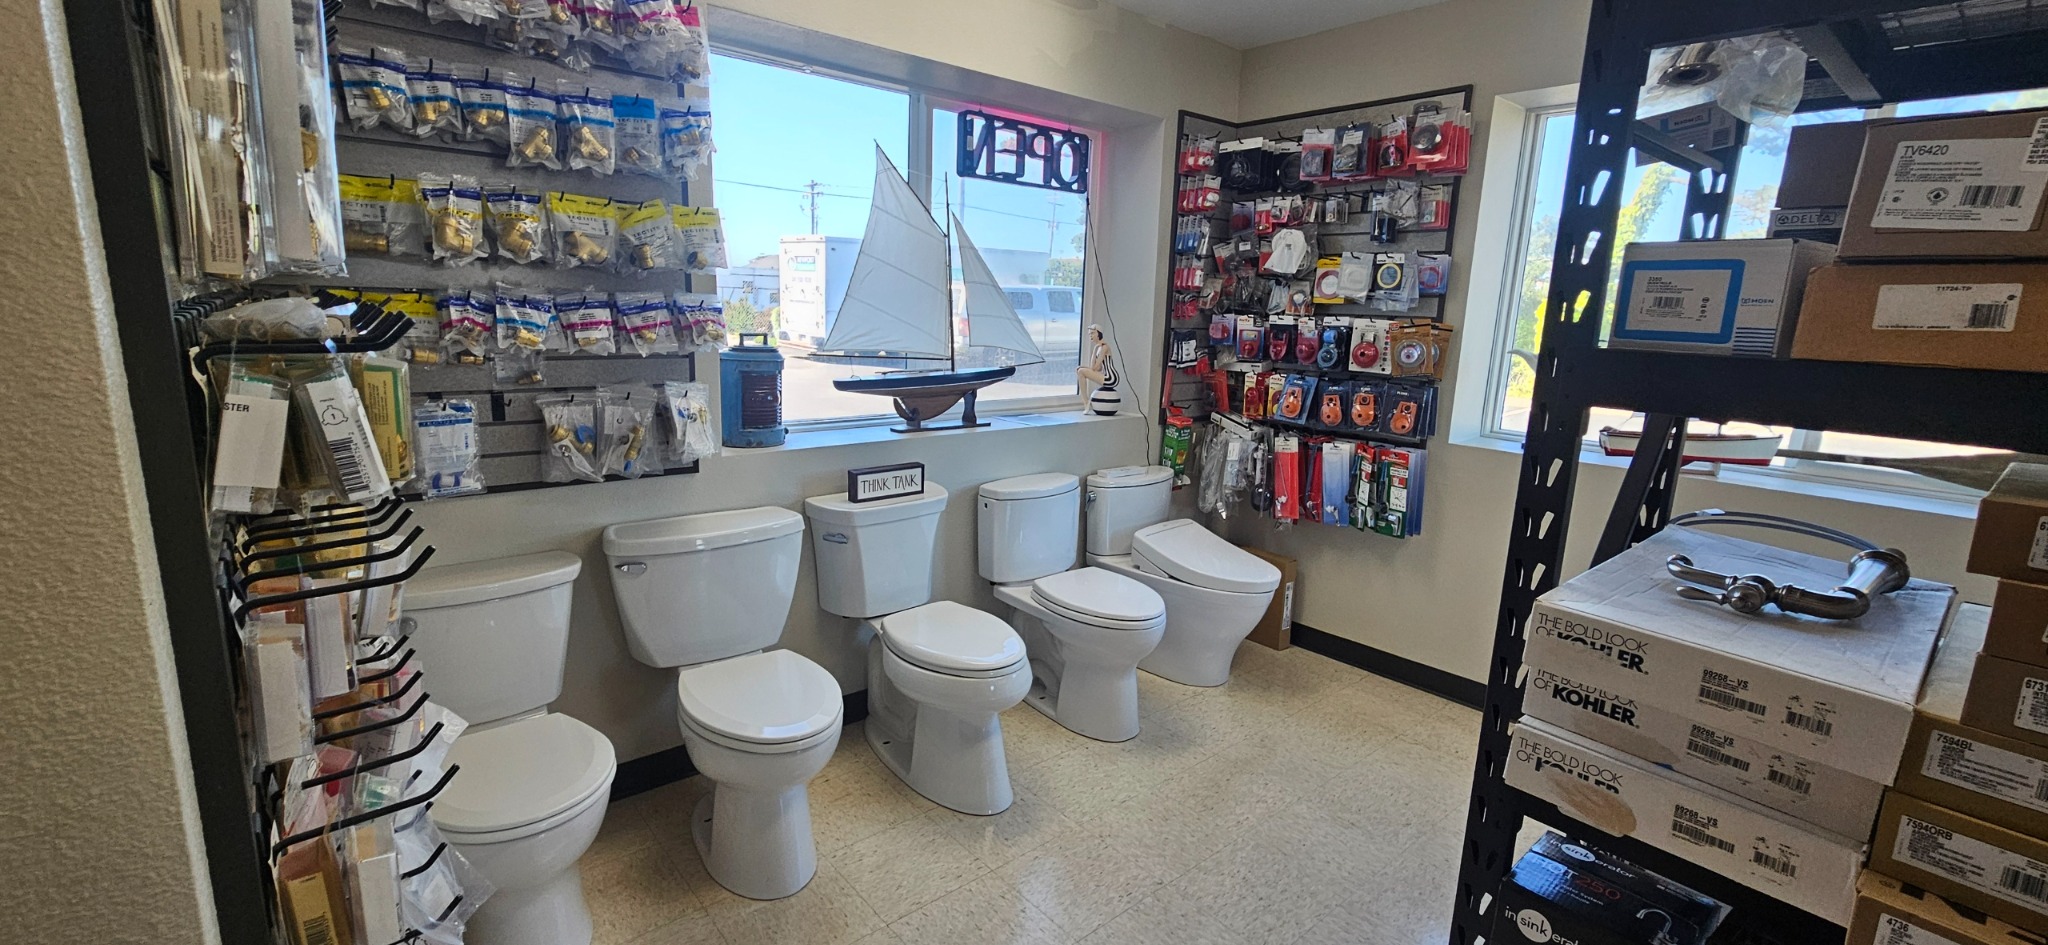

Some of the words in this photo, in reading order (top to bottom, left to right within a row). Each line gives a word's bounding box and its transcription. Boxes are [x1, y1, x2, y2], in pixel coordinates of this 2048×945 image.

[1903, 144, 1950, 156] TV6420
[1790, 213, 1834, 225] DELTA
[860, 477, 891, 494] THINK
[891, 473, 919, 491] TANK
[1538, 612, 1562, 628] THE
[1564, 620, 1603, 640] BOLD
[1605, 631, 1649, 655] LOOK
[1702, 669, 1749, 689] 99268-VS
[1533, 678, 1552, 691] OF
[1551, 684, 1637, 728] KOHLER
[1691, 724, 1735, 746] 99268-VS
[1936, 733, 1975, 752] 7594BL
[1516, 749, 1535, 764] OF
[1519, 737, 1542, 756] THE
[1543, 747, 1580, 768] BOLD
[1582, 761, 1624, 787] LOOK
[1905, 818, 1954, 841] 7594ORB
[1886, 917, 1910, 933] 4736
